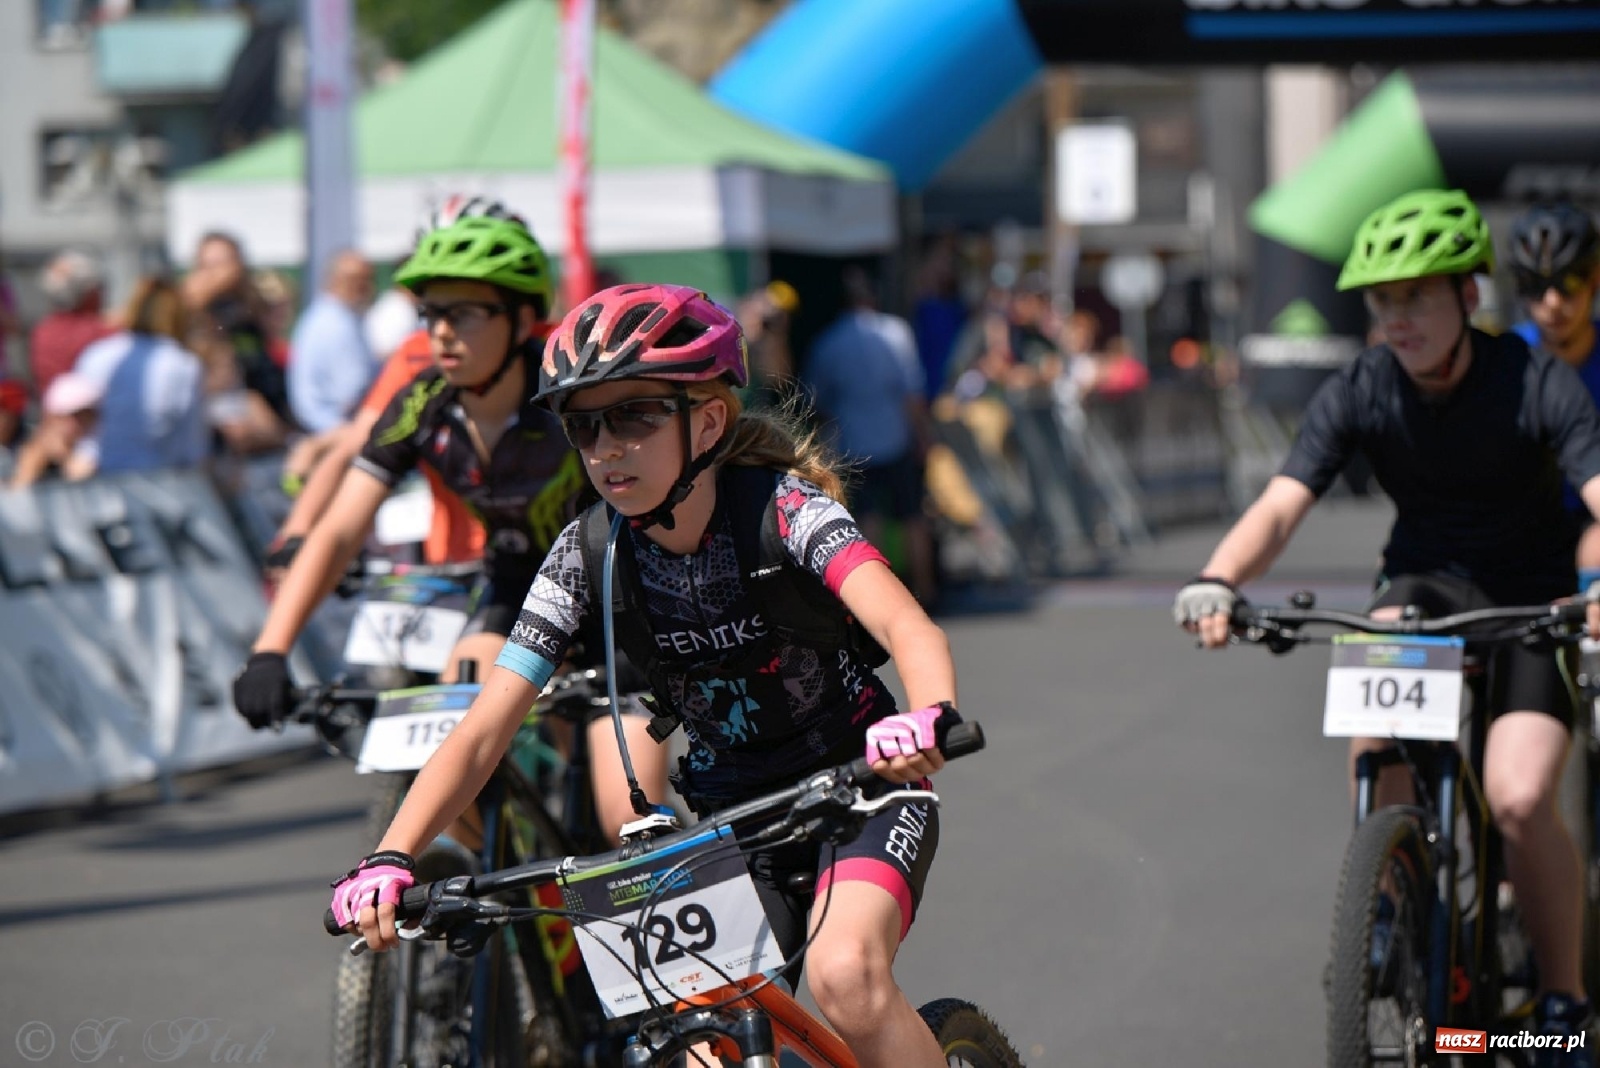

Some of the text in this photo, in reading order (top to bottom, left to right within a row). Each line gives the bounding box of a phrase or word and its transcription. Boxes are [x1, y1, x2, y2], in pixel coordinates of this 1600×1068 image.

[655, 613, 768, 654] FENIKS
[1359, 677, 1427, 710] 104
[406, 718, 458, 746] 119
[621, 903, 717, 970] 129
